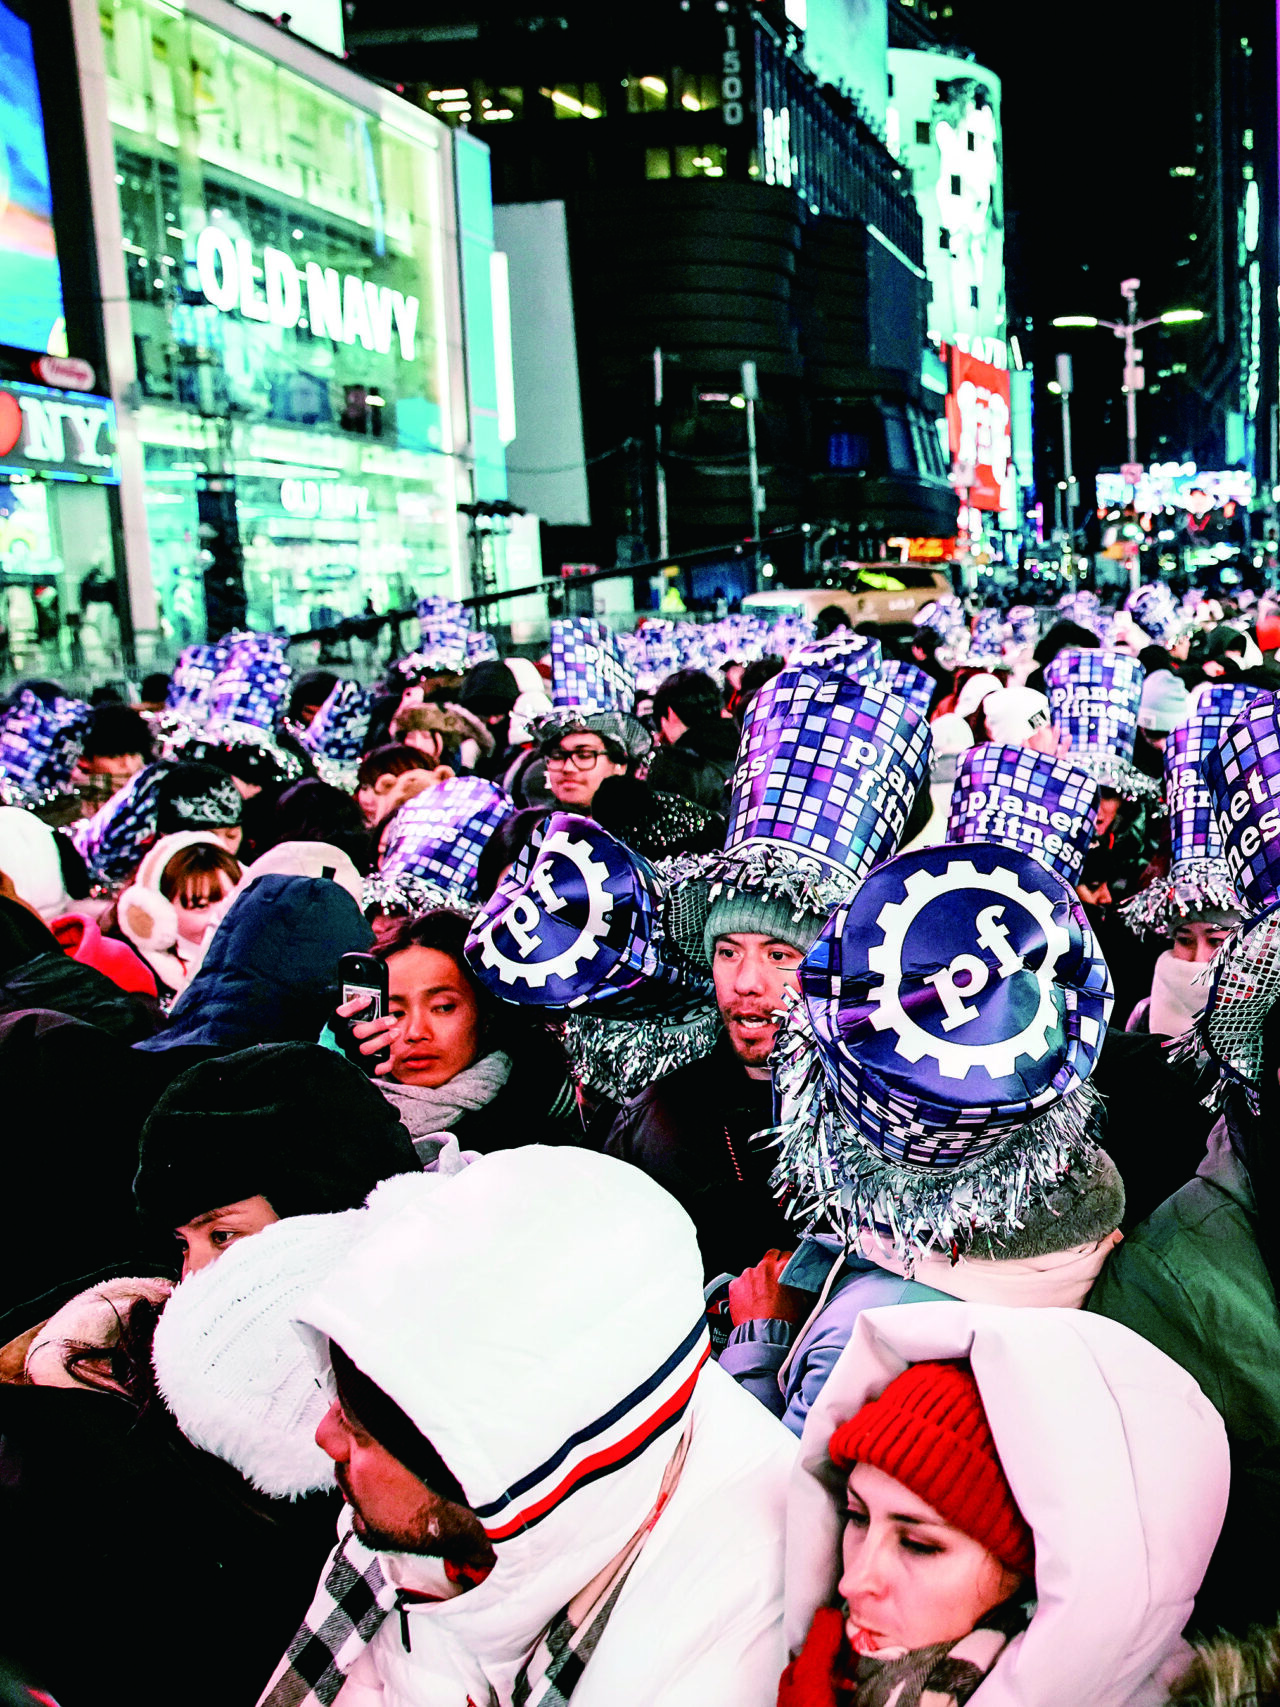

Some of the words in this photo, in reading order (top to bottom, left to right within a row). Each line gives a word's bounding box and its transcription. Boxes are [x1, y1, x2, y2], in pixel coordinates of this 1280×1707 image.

[722, 25, 743, 125] 1500
[197, 226, 301, 329] OLD
[305, 261, 420, 361] NAVY
[966, 784, 1084, 839] planet
[975, 809, 1085, 871] fitness
[501, 860, 568, 959] pf
[922, 904, 1025, 1033] pf
